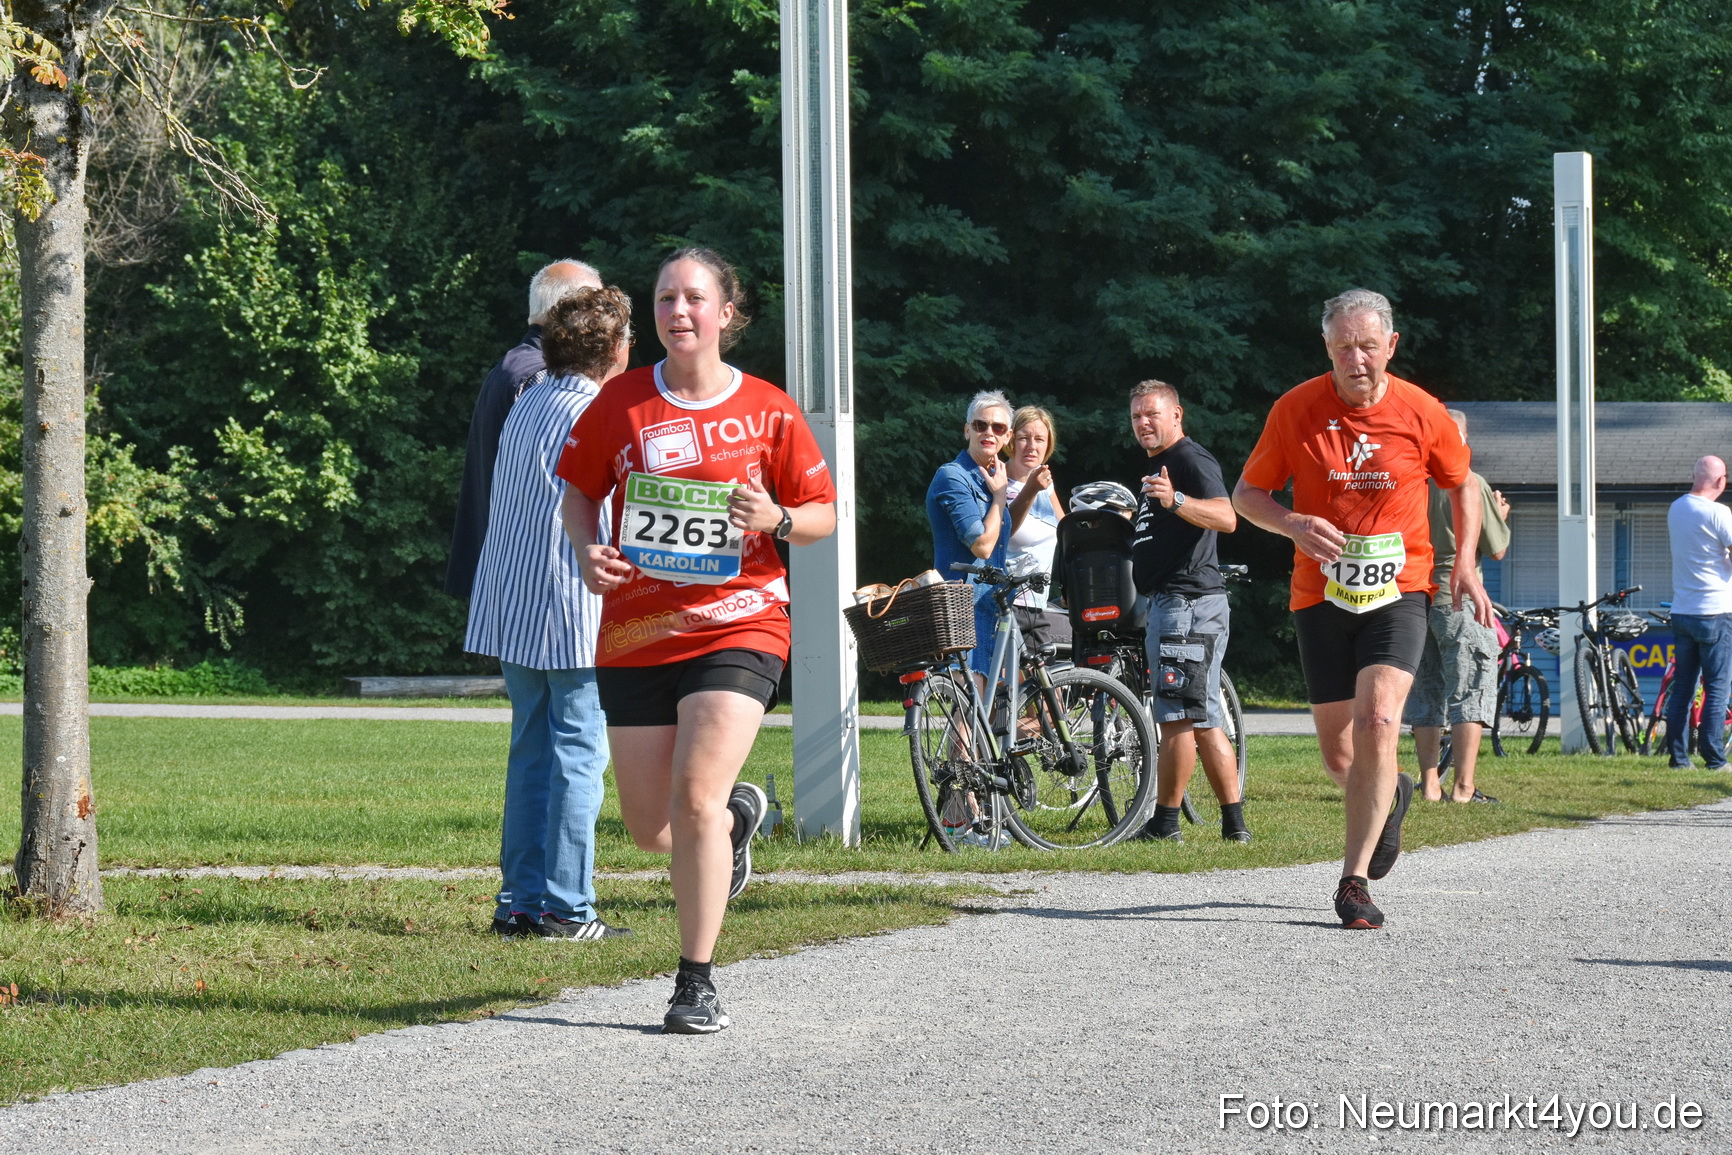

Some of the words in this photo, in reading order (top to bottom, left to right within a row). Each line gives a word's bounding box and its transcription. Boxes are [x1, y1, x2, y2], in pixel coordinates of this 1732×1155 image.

[643, 422, 691, 440] raumbox
[1327, 469, 1390, 482] funrunners
[1344, 479, 1397, 490] neumarkt
[635, 478, 731, 508] BOCK
[635, 510, 729, 549] 2263
[638, 551, 720, 573] KAROLIN
[1331, 561, 1396, 587] 1288
[602, 610, 682, 653] Team
[684, 594, 758, 626] raumbox
